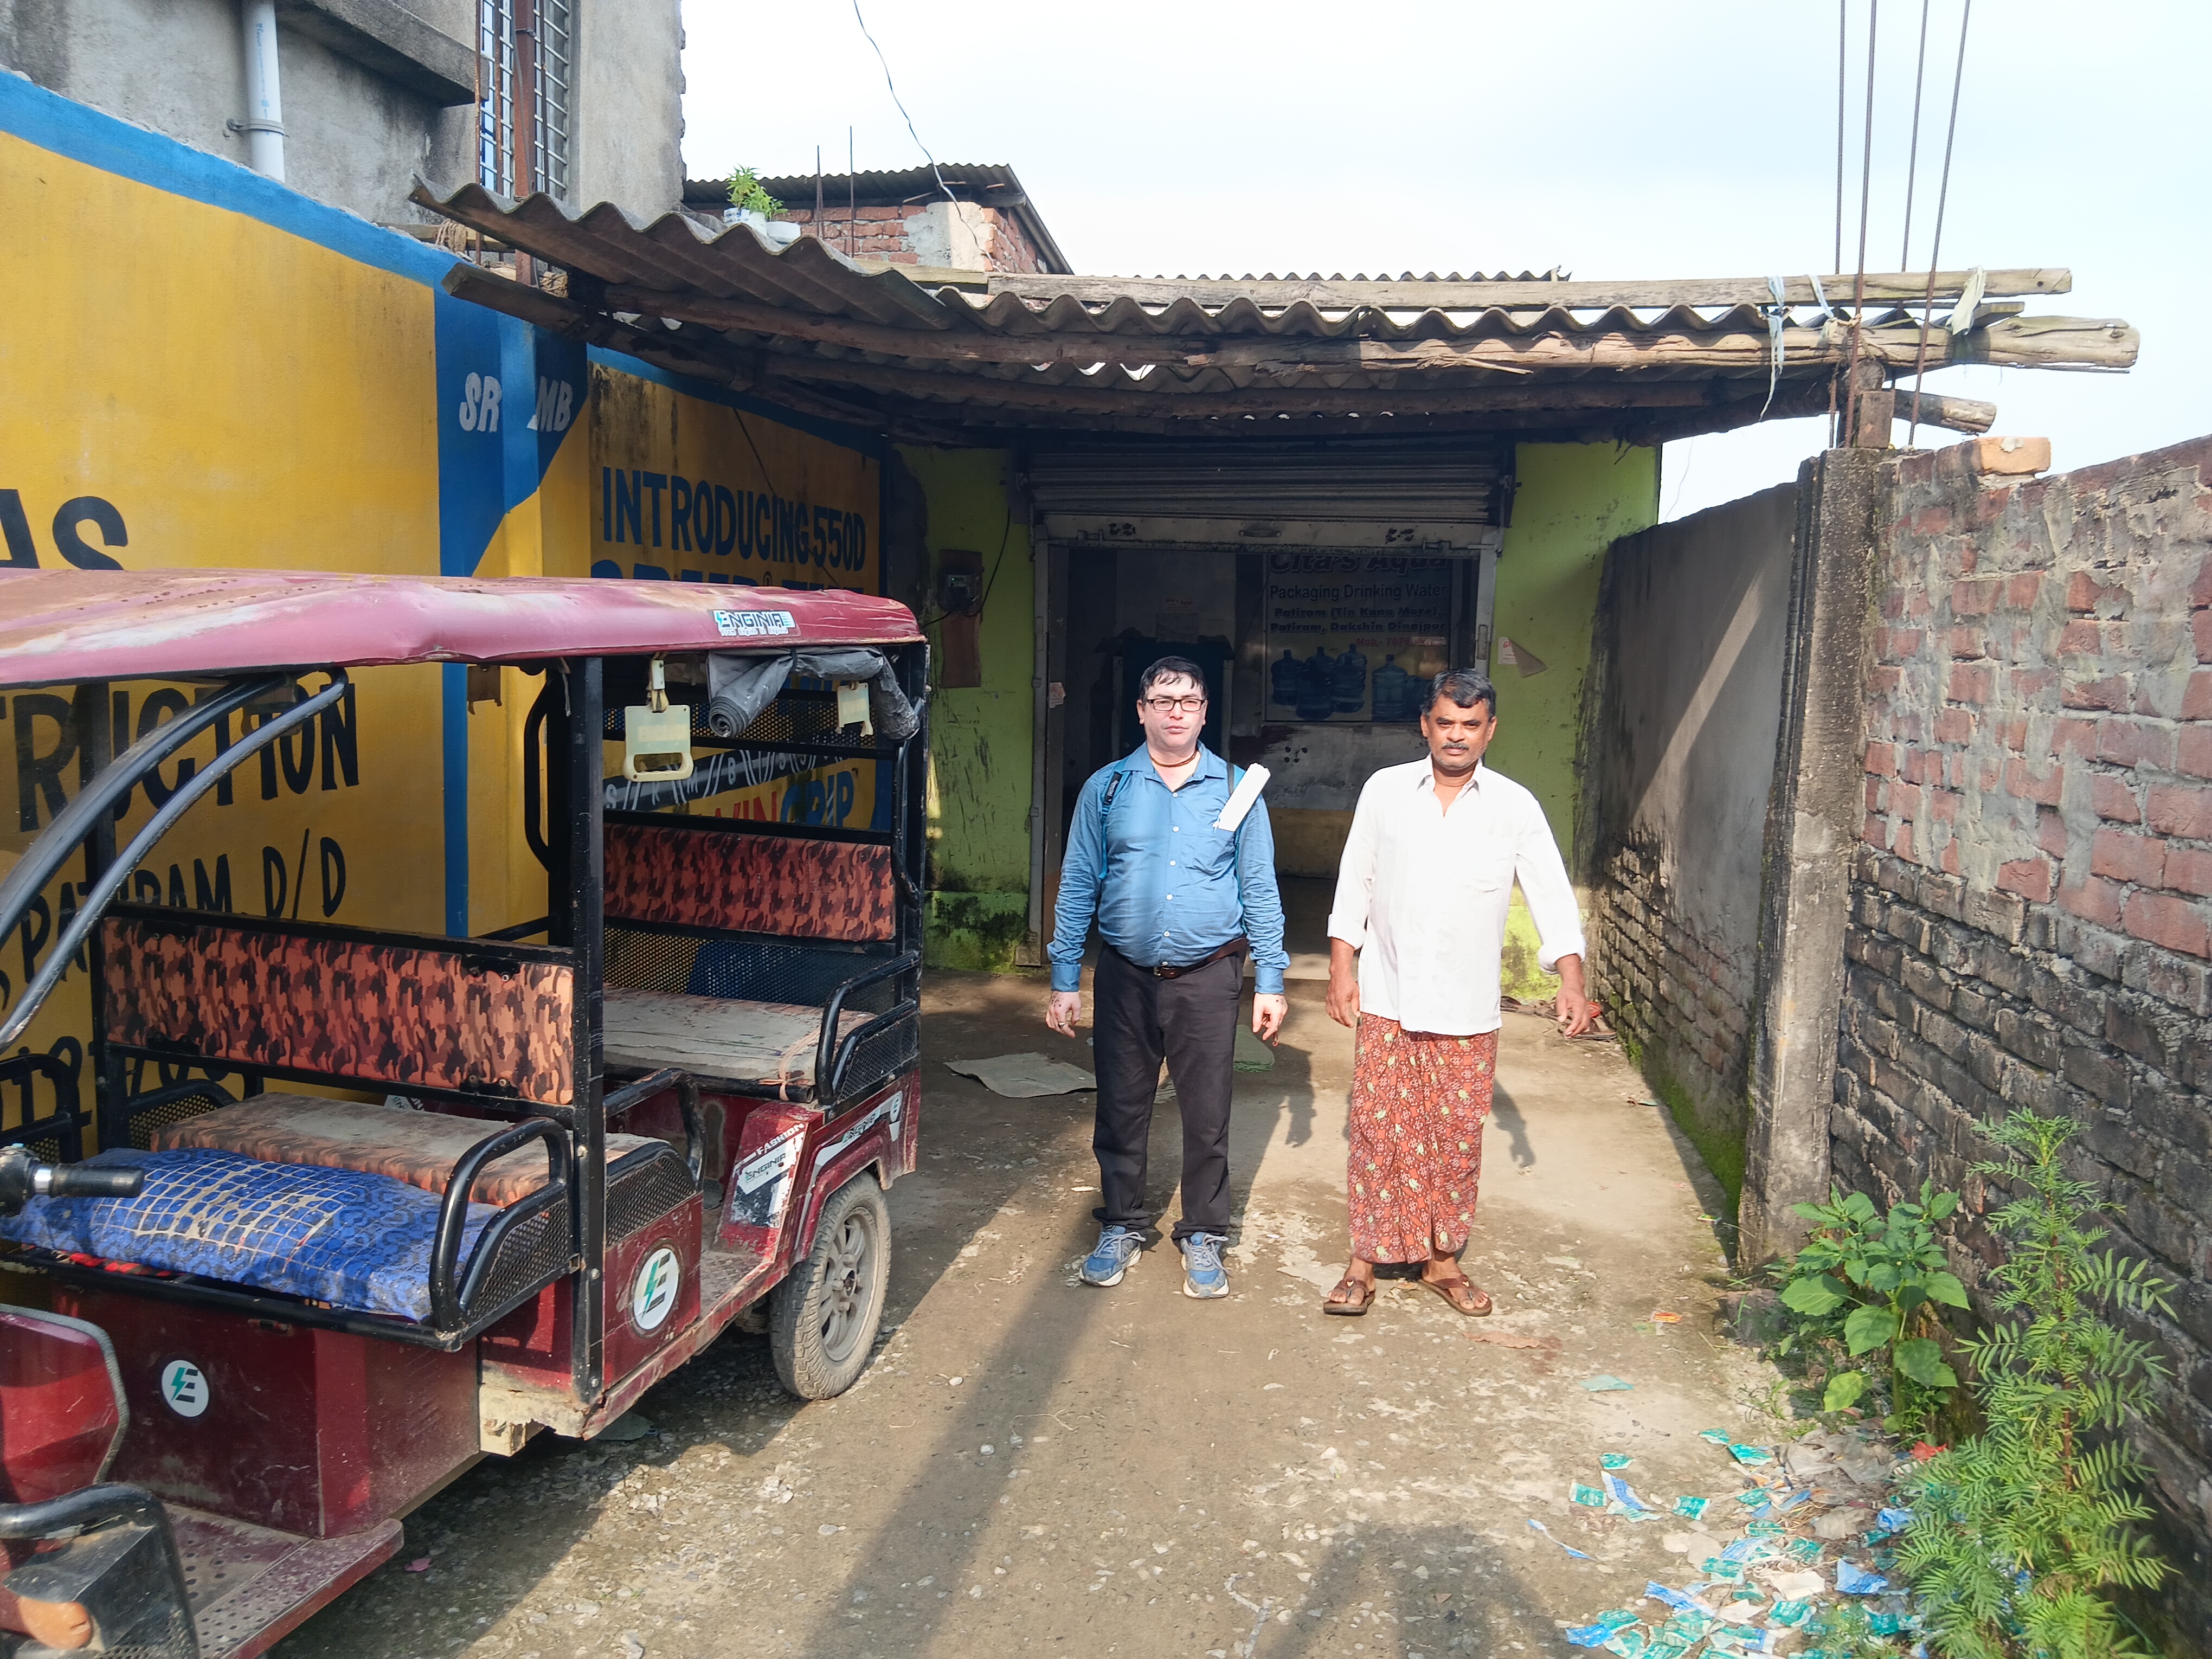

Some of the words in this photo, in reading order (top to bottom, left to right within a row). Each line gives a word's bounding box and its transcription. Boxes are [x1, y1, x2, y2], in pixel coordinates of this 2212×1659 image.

[603, 466, 809, 565] INTRODUCING
[813, 505, 866, 572] 550D
[1366, 557, 1449, 576] Aqua
[1270, 585, 1340, 601] Packaging
[1345, 584, 1401, 600] Drinking
[1406, 582, 1448, 597] Water
[715, 610, 787, 628] ENGINIA
[1275, 607, 1327, 618] Patiram
[1360, 607, 1394, 617] Kona
[1330, 622, 1384, 632] Dakshin
[1388, 621, 1446, 634] Dinajpur
[0, 682, 359, 833] RUCTION
[756, 1122, 805, 1155] FASHION
[745, 1153, 786, 1183] ENGINIA
